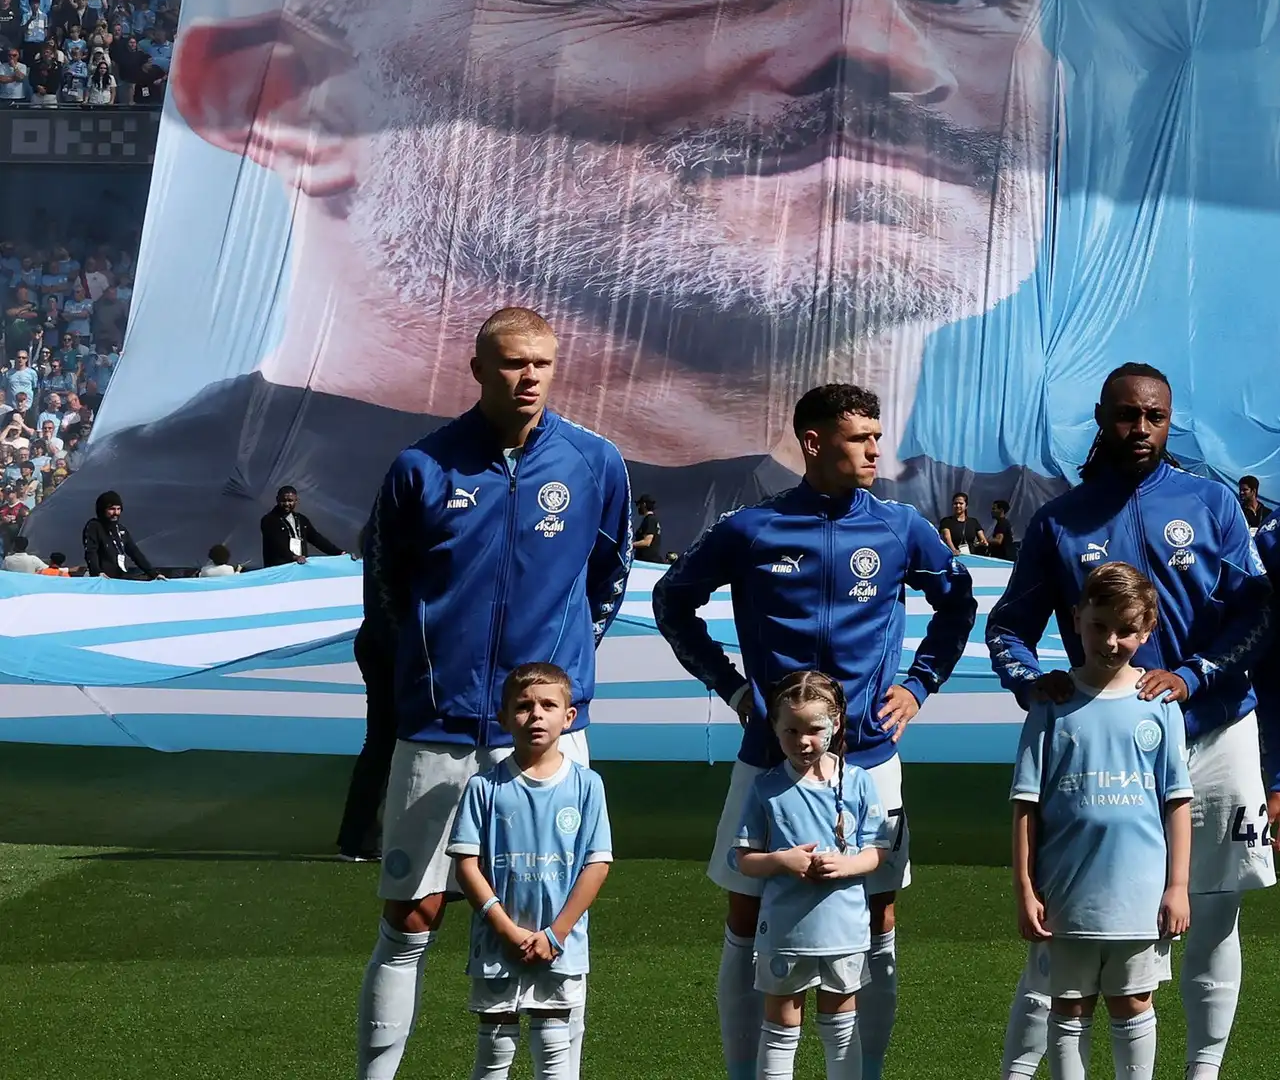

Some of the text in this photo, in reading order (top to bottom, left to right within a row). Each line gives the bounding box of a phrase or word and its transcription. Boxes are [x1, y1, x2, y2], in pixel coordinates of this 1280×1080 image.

[447, 498, 468, 508] KING
[1081, 553, 1100, 563] KING
[771, 564, 792, 573] KING
[1057, 771, 1156, 792] ETIHAD
[1080, 794, 1145, 806] AIRWAYS
[492, 851, 575, 869] ETIHAD
[511, 871, 565, 882] AIRWAYS
